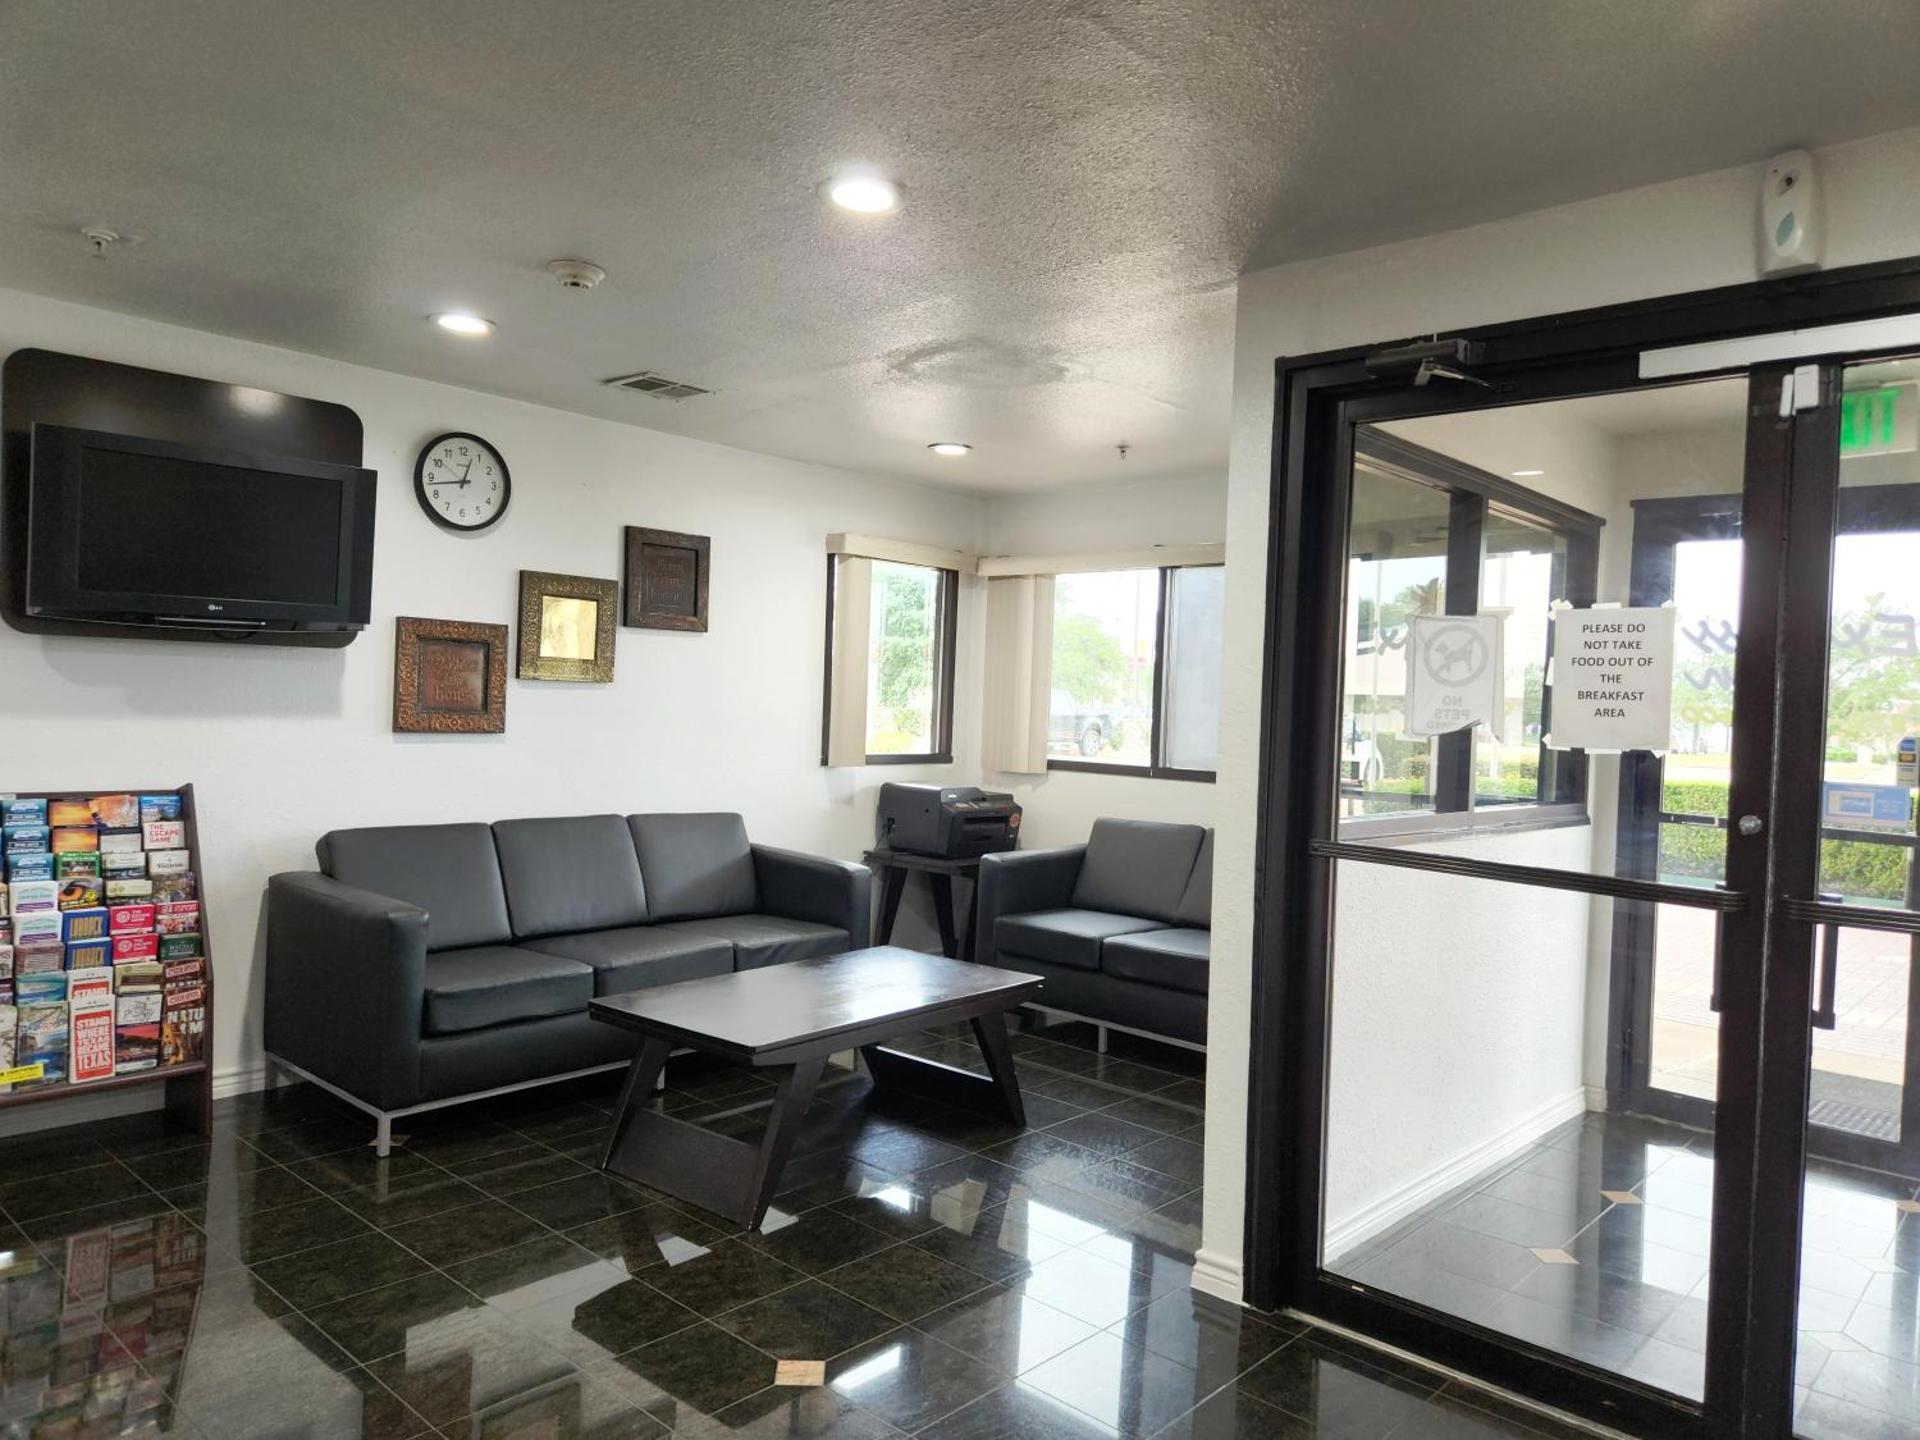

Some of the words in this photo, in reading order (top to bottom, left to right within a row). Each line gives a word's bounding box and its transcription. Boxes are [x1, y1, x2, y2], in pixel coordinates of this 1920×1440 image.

[444, 449, 453, 458] 11
[458, 446, 468, 456] 12
[433, 458, 443, 468] 10
[486, 466, 492, 475] 2
[428, 472, 434, 481] 9
[491, 481, 497, 490] 3
[433, 489, 439, 499] 8
[485, 497, 491, 506] 4
[444, 502, 450, 511] 7
[475, 506, 481, 515] 5
[459, 508, 465, 517] 6
[1582, 624, 1623, 633] PLEASE
[1627, 623, 1646, 633] DO
[1583, 640, 1609, 650] NOT
[1612, 640, 1643, 650] TAKE
[1571, 657, 1605, 667] FOOD
[1608, 657, 1634, 667] OUT
[1637, 657, 1654, 667] OF
[1600, 674, 1622, 684] THE
[1577, 690, 1645, 701] BREAKFAST
[1594, 708, 1625, 717] AREA
[78, 1051, 112, 1072] TEXAS
